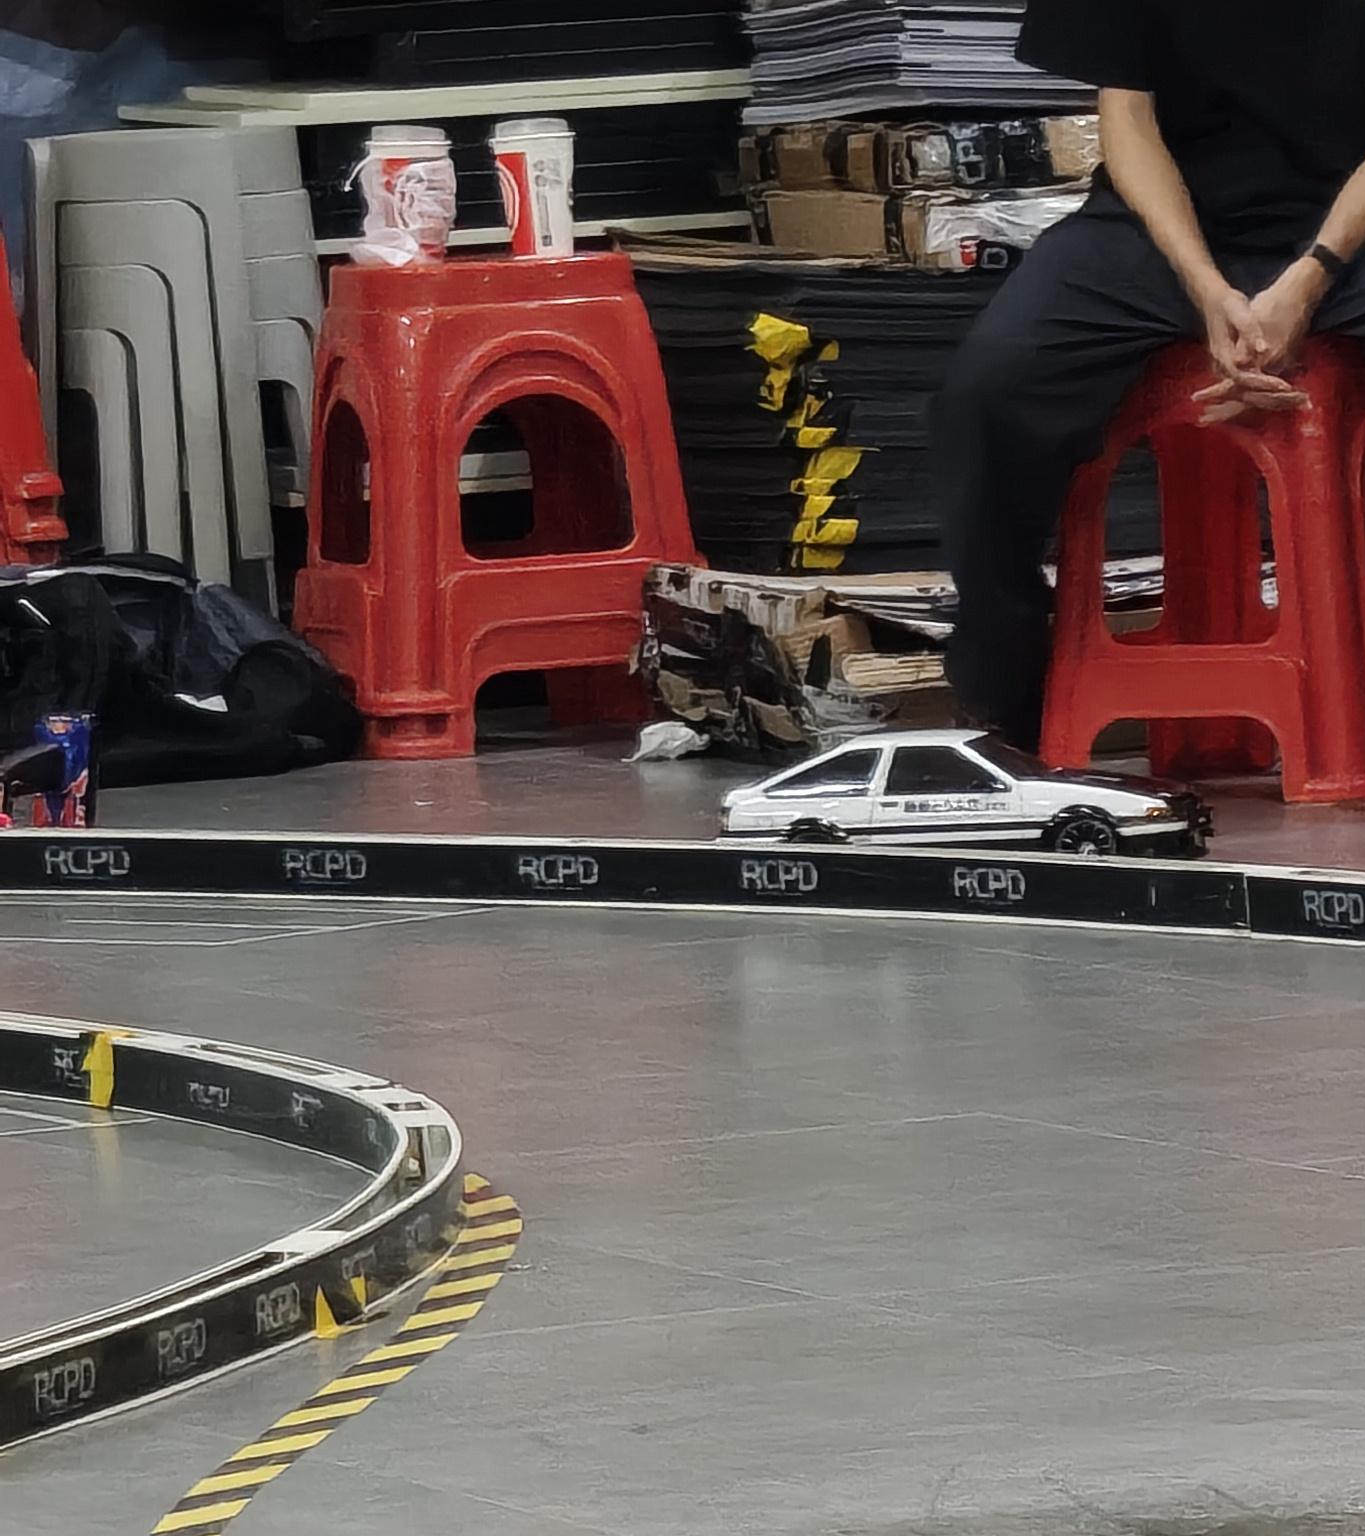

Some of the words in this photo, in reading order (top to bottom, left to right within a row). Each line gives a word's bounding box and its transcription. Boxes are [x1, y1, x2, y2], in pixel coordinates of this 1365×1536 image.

[45, 846, 130, 875] RCPD
[283, 849, 367, 879] RCPD
[518, 855, 598, 884] RCPD
[741, 860, 818, 892] RCPD
[953, 868, 1026, 900] RCPD
[1303, 890, 1364, 925] RCPD
[256, 1283, 300, 1334] RCPD
[158, 1318, 207, 1372] RCPD
[34, 1357, 95, 1412] RCPD
